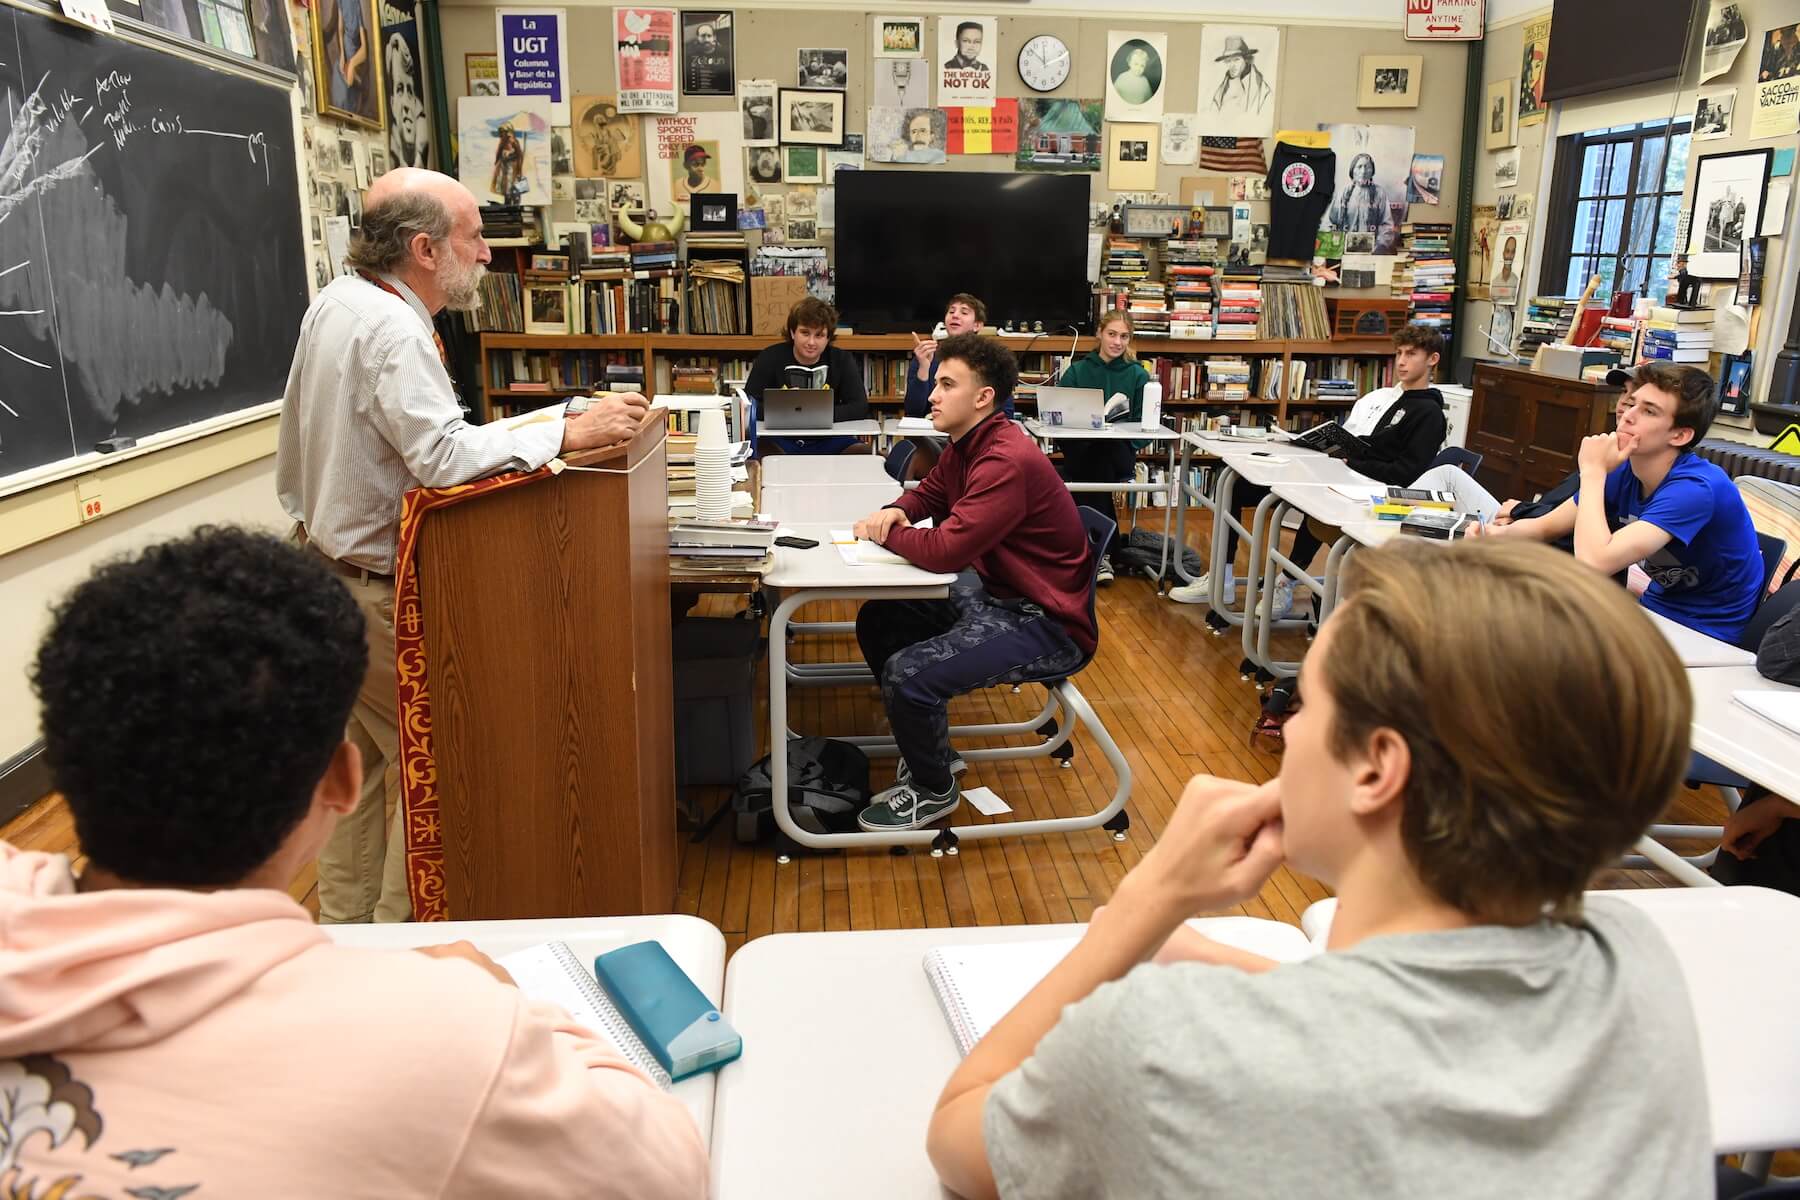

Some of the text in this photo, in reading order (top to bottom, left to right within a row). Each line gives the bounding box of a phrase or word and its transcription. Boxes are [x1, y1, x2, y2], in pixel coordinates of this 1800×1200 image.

[1408, 0, 1431, 10] NO
[1425, 15, 1463, 23] ANYTIME
[522, 18, 537, 30] La
[513, 37, 549, 54] UGT
[514, 59, 549, 67] Columna
[516, 70, 534, 78] Base
[536, 70, 546, 78] de
[547, 70, 555, 78] la
[513, 80, 552, 91] República
[944, 78, 989, 89] NOT OK
[1761, 82, 1791, 98] SACCO
[1760, 92, 1798, 108] VANZETTI
[656, 117, 697, 125] WITHOUT
[657, 126, 695, 134] SPORTS,
[658, 143, 680, 151] ONLY
[658, 151, 679, 159] GUM
